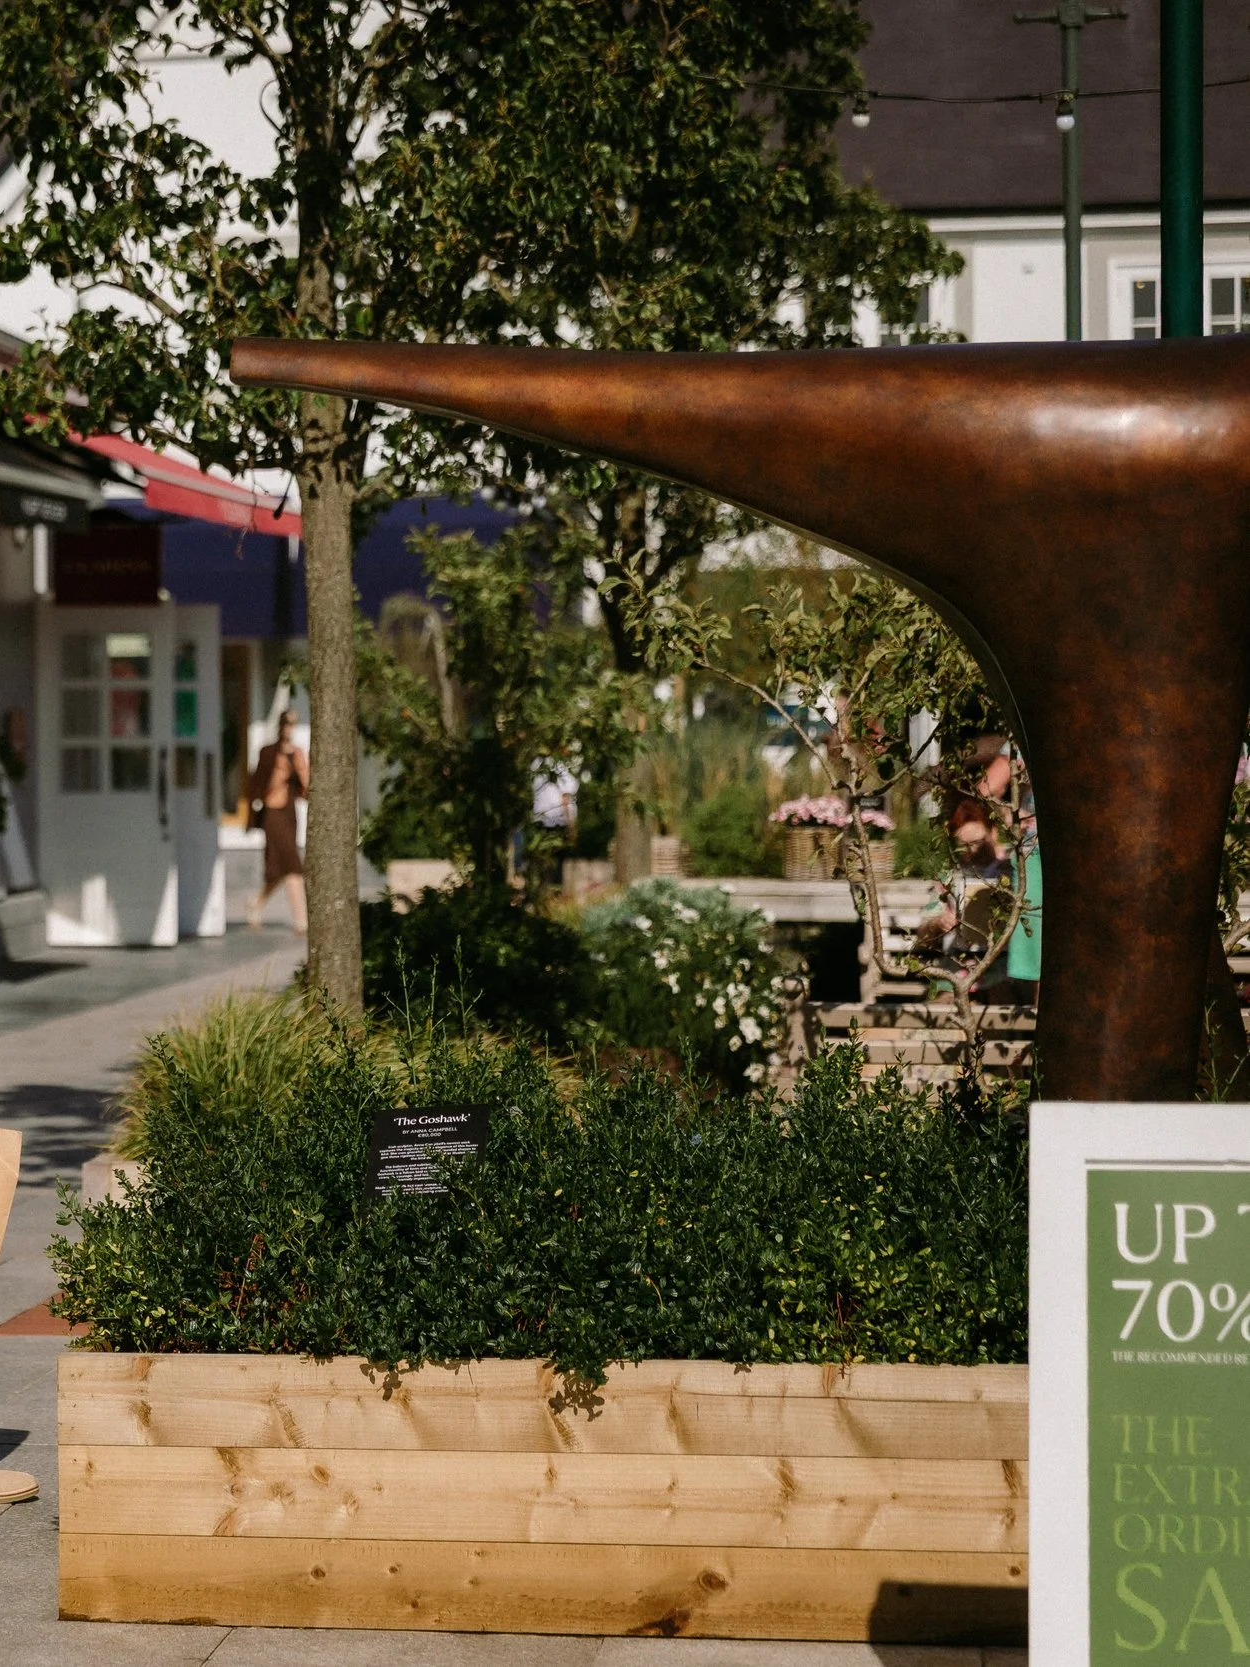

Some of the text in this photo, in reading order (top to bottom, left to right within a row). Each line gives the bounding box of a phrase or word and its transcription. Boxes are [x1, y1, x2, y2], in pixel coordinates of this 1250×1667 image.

[1114, 1203, 1216, 1264] UP
[1112, 1279, 1250, 1342] 70%
[1111, 1350, 1134, 1362] THE
[1136, 1351, 1232, 1365] RECOMMENDED
[1112, 1414, 1212, 1456] THE
[1113, 1463, 1250, 1506] EXTR
[1113, 1512, 1250, 1557] ORDI
[1115, 1562, 1250, 1654] SA
